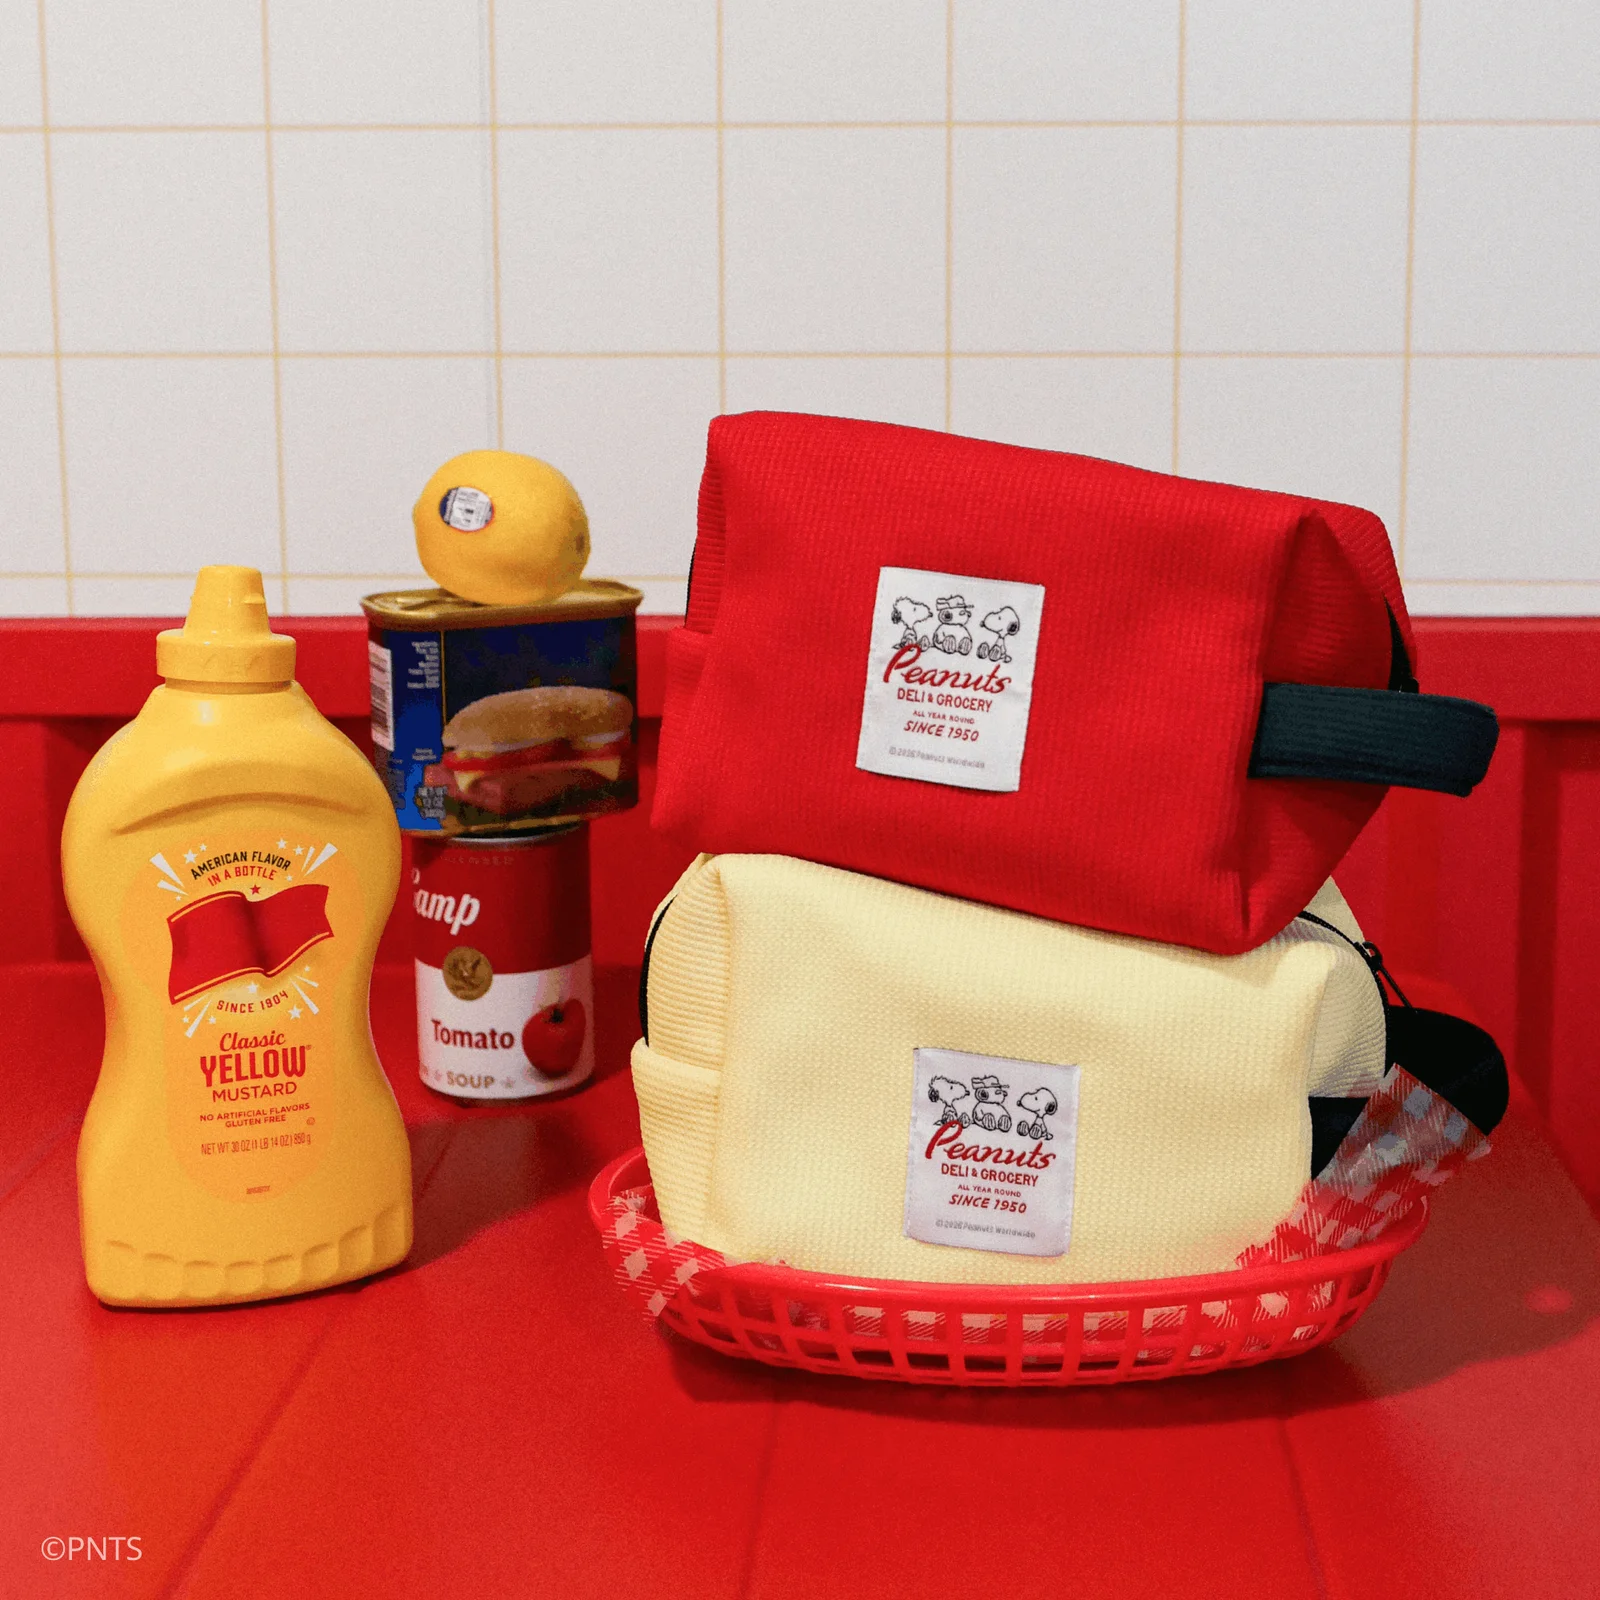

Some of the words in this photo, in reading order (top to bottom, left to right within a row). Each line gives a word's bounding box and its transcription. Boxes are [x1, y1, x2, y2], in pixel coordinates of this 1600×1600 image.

[883, 643, 1012, 694] Peanuts
[897, 687, 926, 703] DELI
[927, 693, 934, 703] &
[936, 693, 993, 713] GROCERY
[912, 710, 925, 718] ALL
[927, 711, 946, 720] YEAR
[949, 715, 975, 725] ROUND
[903, 720, 946, 737] SINCE
[947, 727, 980, 742] 1950
[190, 851, 248, 880] AMERICAN
[251, 851, 292, 871] FLAVOR
[207, 873, 222, 887] IN
[224, 871, 232, 880] A
[234, 866, 277, 881] BOTTLE
[217, 1000, 255, 1014] SINCE
[260, 990, 289, 1011] 1904
[219, 1030, 286, 1052] Classic
[431, 1018, 515, 1050] Tomato
[446, 1070, 495, 1089] SOUP
[212, 1081, 298, 1103] MUSTARD
[199, 1113, 214, 1122] NO
[216, 1109, 268, 1120] ARTIFICIAL
[269, 1102, 310, 1115] FLAVORS
[225, 1117, 261, 1128] GLUTEN
[263, 1114, 286, 1124] FREE
[201, 1142, 215, 1155] NET
[217, 1141, 230, 1154] WT
[240, 1139, 251, 1152] OZ
[259, 1137, 269, 1150] LB
[924, 1119, 1057, 1169] Peanuts
[940, 1163, 969, 1178] DELI
[971, 1167, 978, 1178] &
[980, 1168, 1039, 1187] GROCERY
[957, 1184, 970, 1192] ALL
[972, 1185, 992, 1194] YEAR
[994, 1188, 1022, 1198] ROUND
[948, 1193, 991, 1209] SINCE
[993, 1199, 1028, 1214] 1950
[963, 1221, 994, 1234] Peanuts
[995, 1225, 1036, 1240] Worldwide
